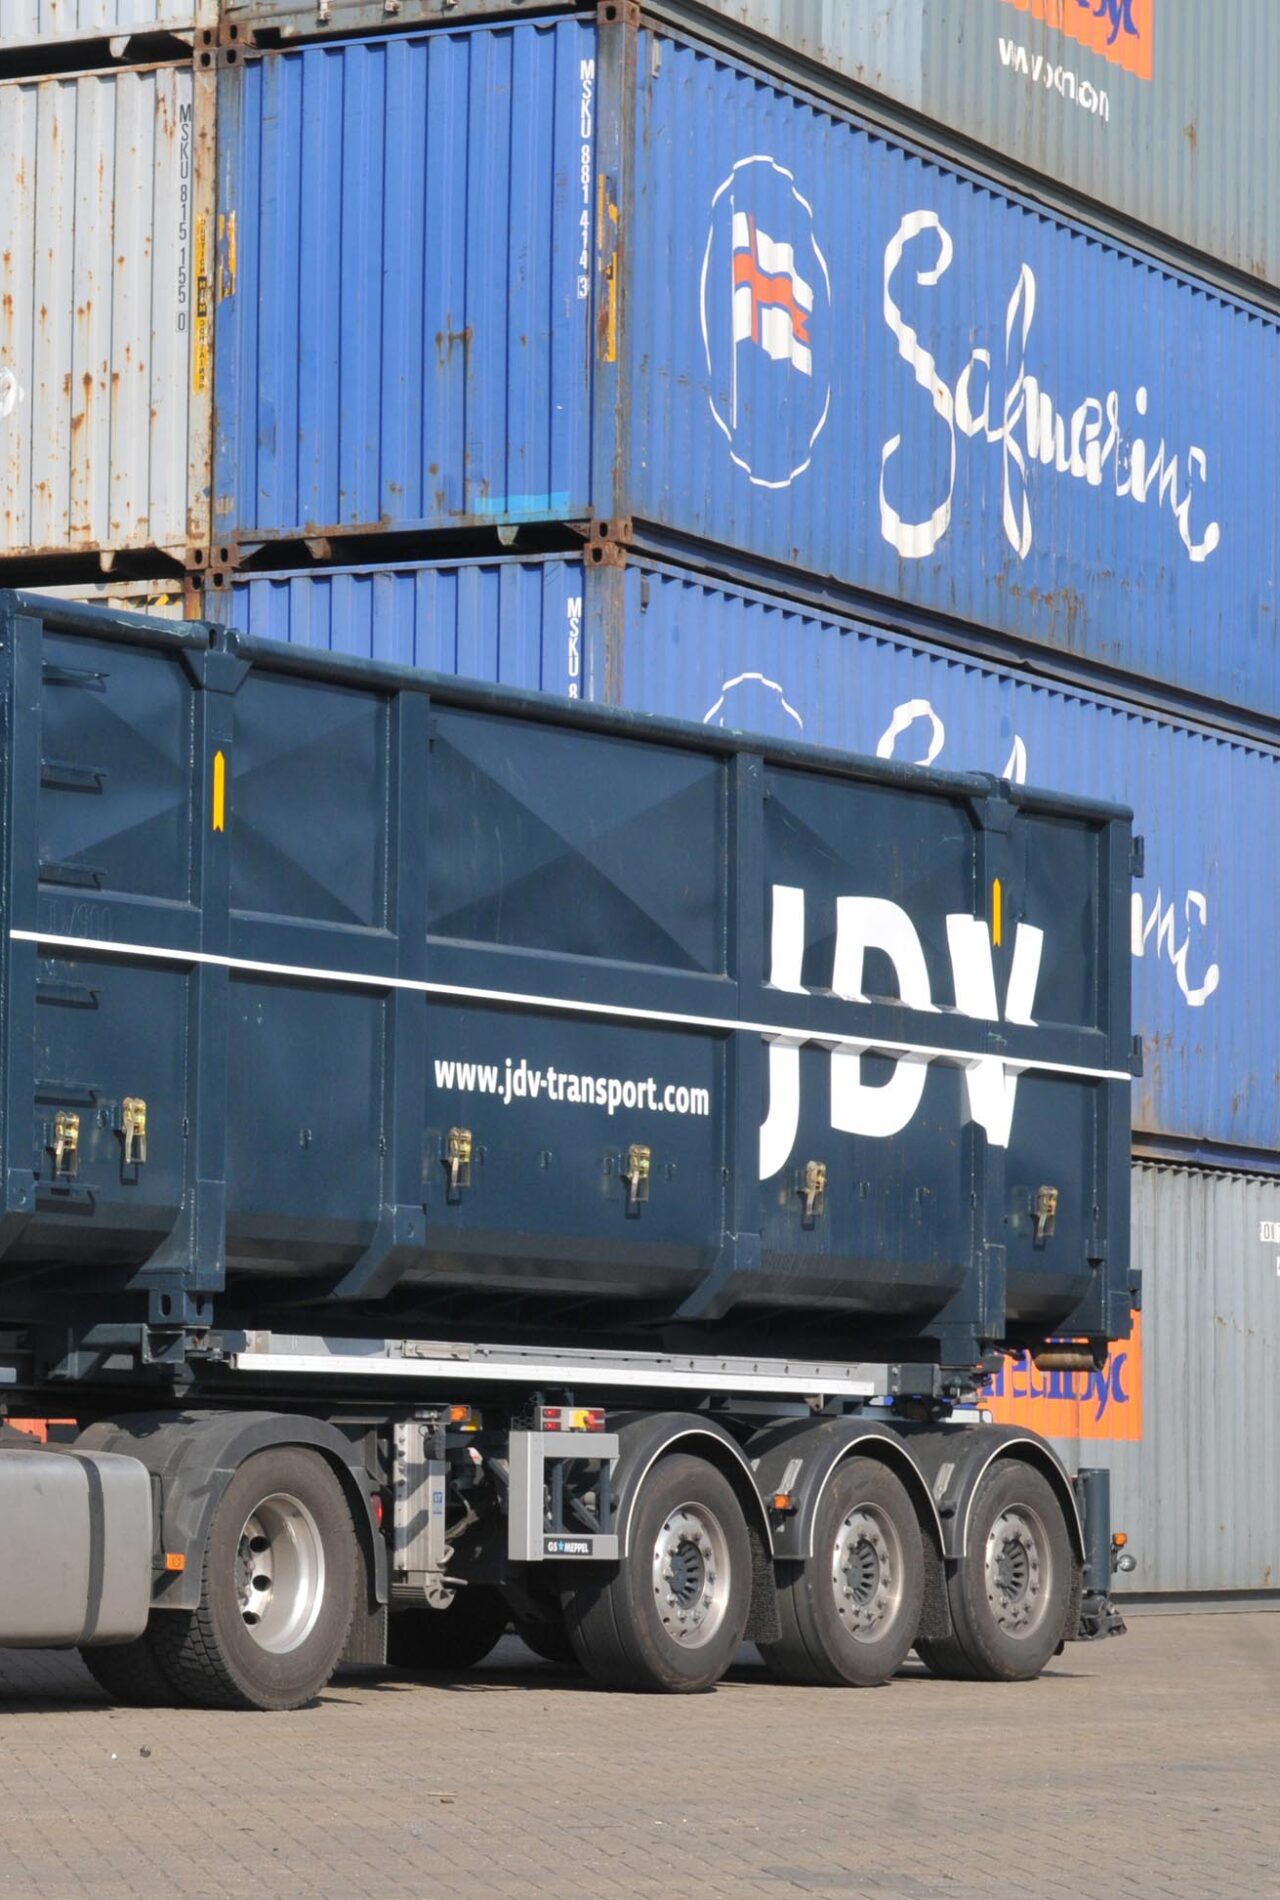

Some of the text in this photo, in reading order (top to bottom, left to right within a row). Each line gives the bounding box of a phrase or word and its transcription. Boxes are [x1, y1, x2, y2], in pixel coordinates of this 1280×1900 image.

[179, 103, 192, 179] MSKU
[578, 59, 595, 297] MSKU 881 414 3
[178, 184, 188, 241] 815
[177, 247, 187, 304] 155
[566, 596, 583, 678] MSKU
[758, 883, 1045, 1182] JDV
[433, 1057, 710, 1116] www.jdv-transport.com
